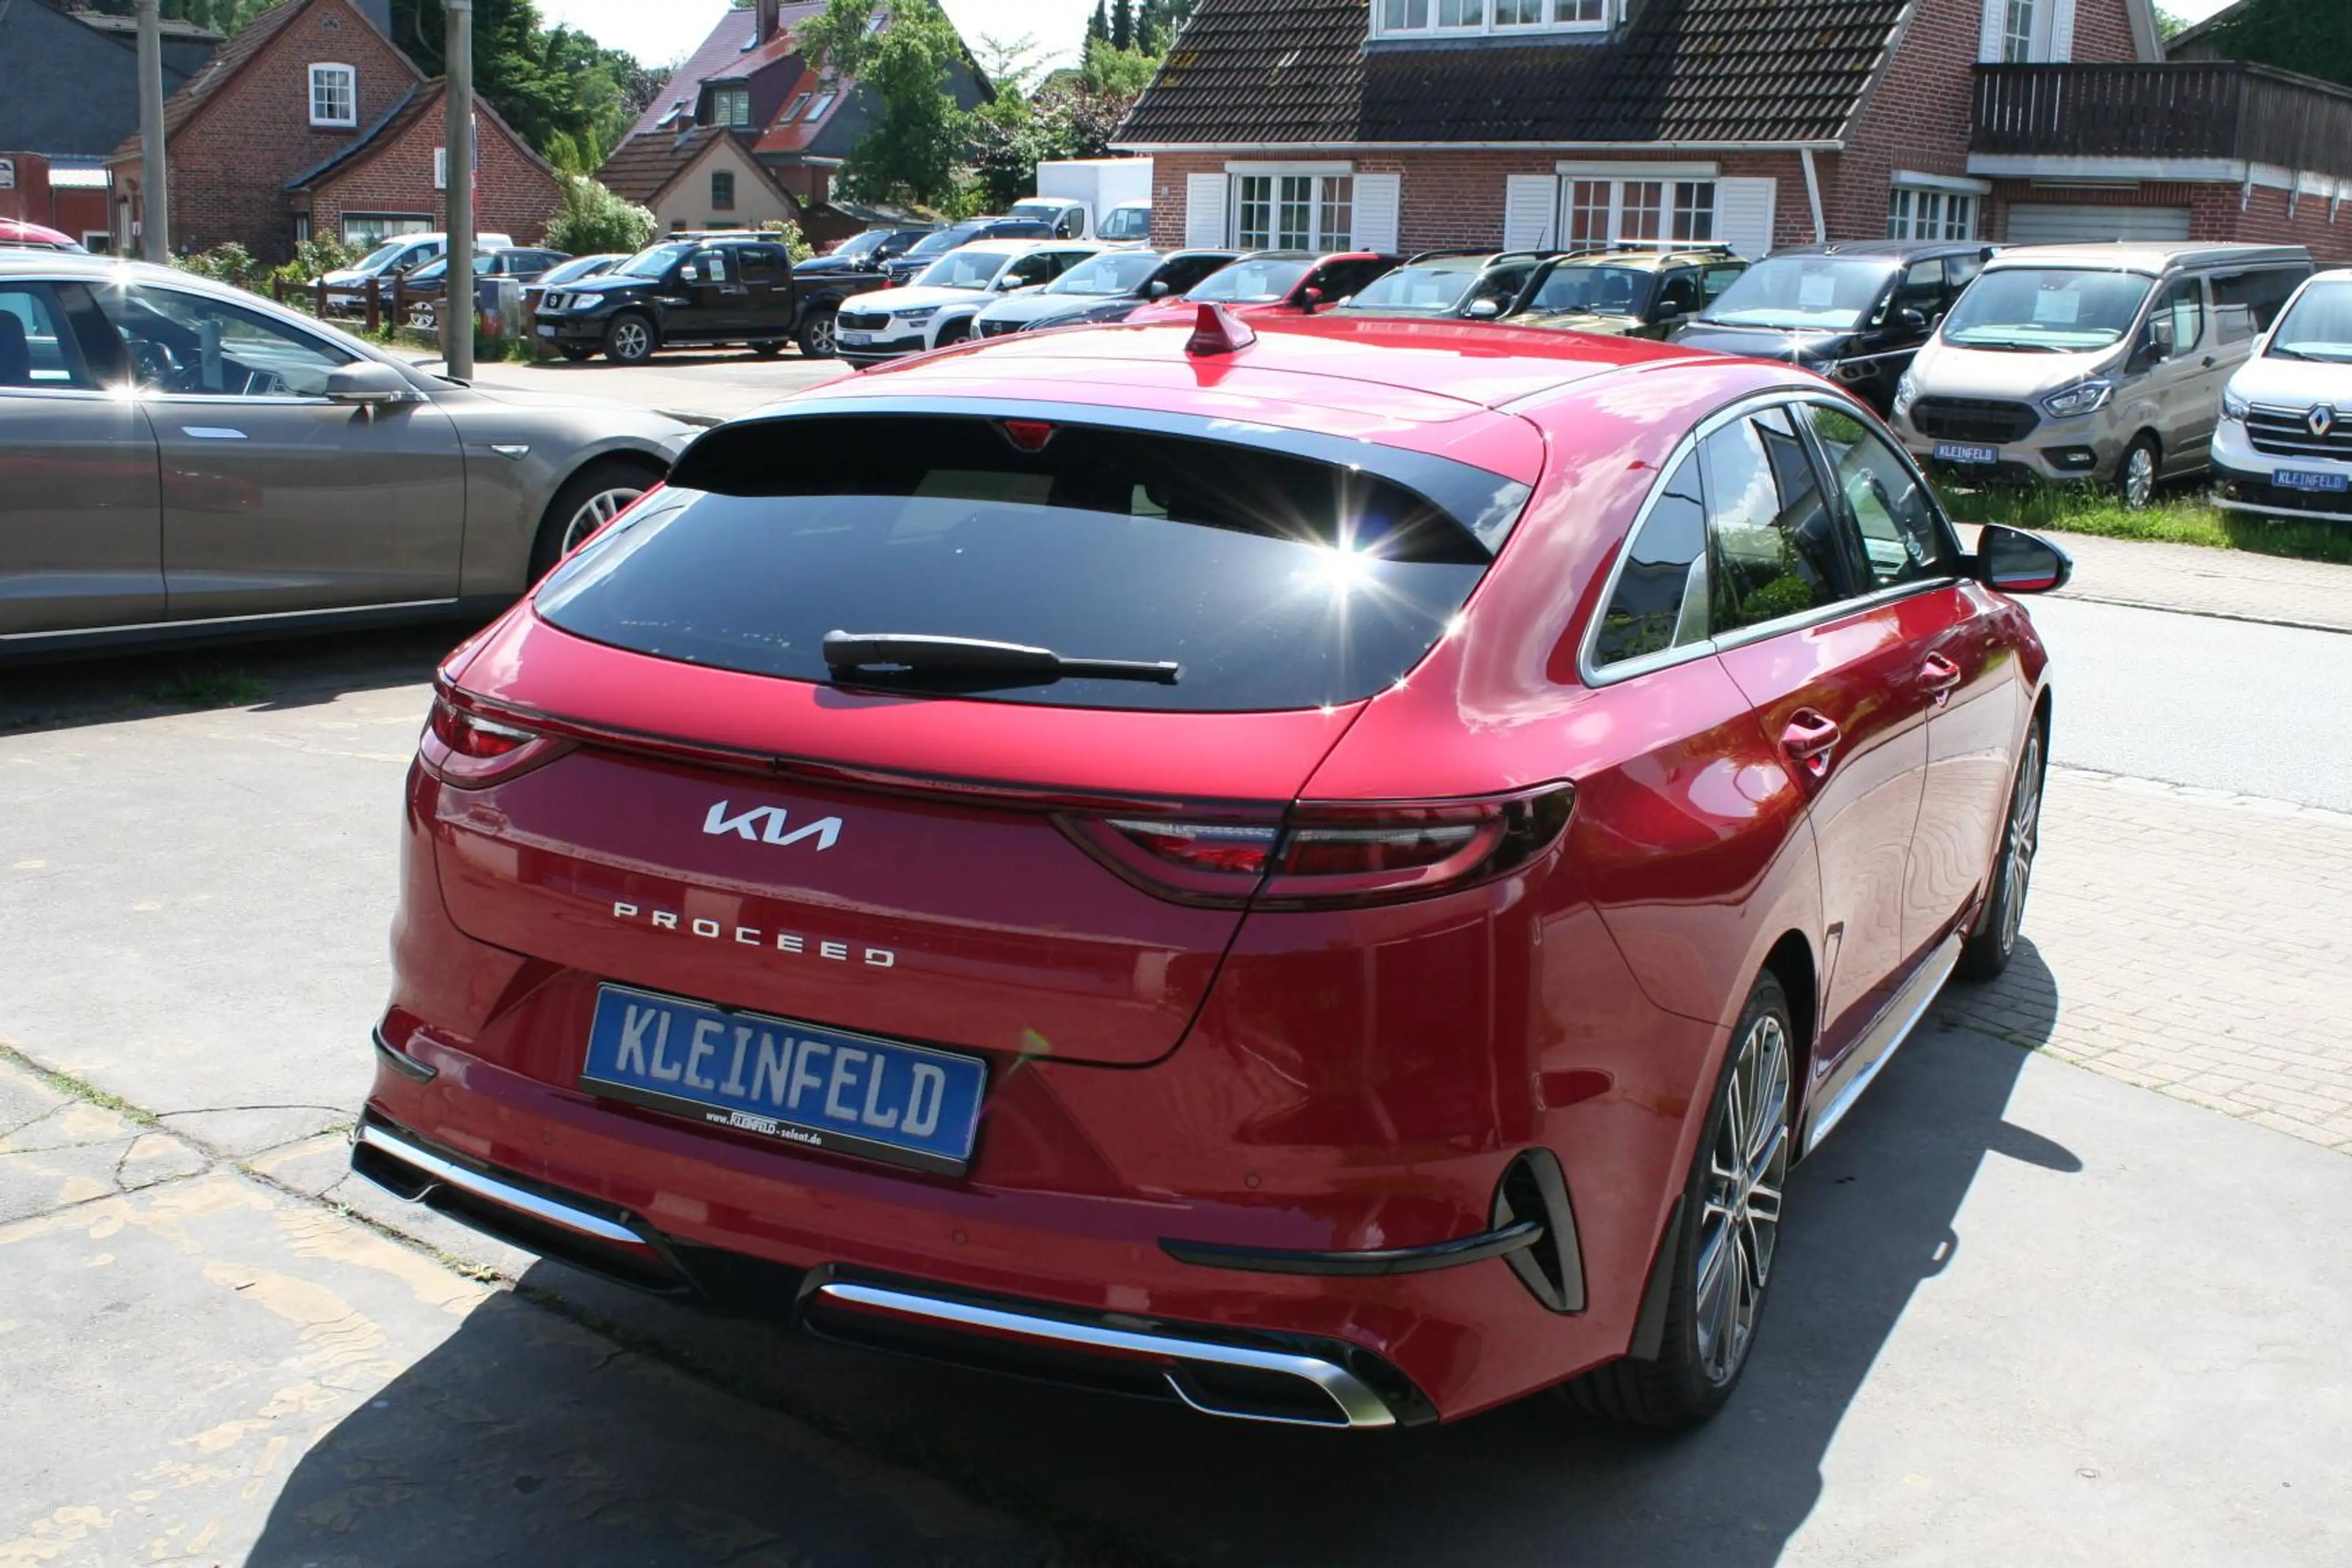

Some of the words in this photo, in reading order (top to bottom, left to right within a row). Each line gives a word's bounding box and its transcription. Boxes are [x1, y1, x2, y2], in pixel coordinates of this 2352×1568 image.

[1939, 446, 1992, 460] KLEINFELD
[2278, 470, 2342, 488] KLEINFELD
[703, 800, 842, 851] KIA
[614, 902, 894, 967] PROCEED
[615, 1005, 945, 1137] KLEINFELD
